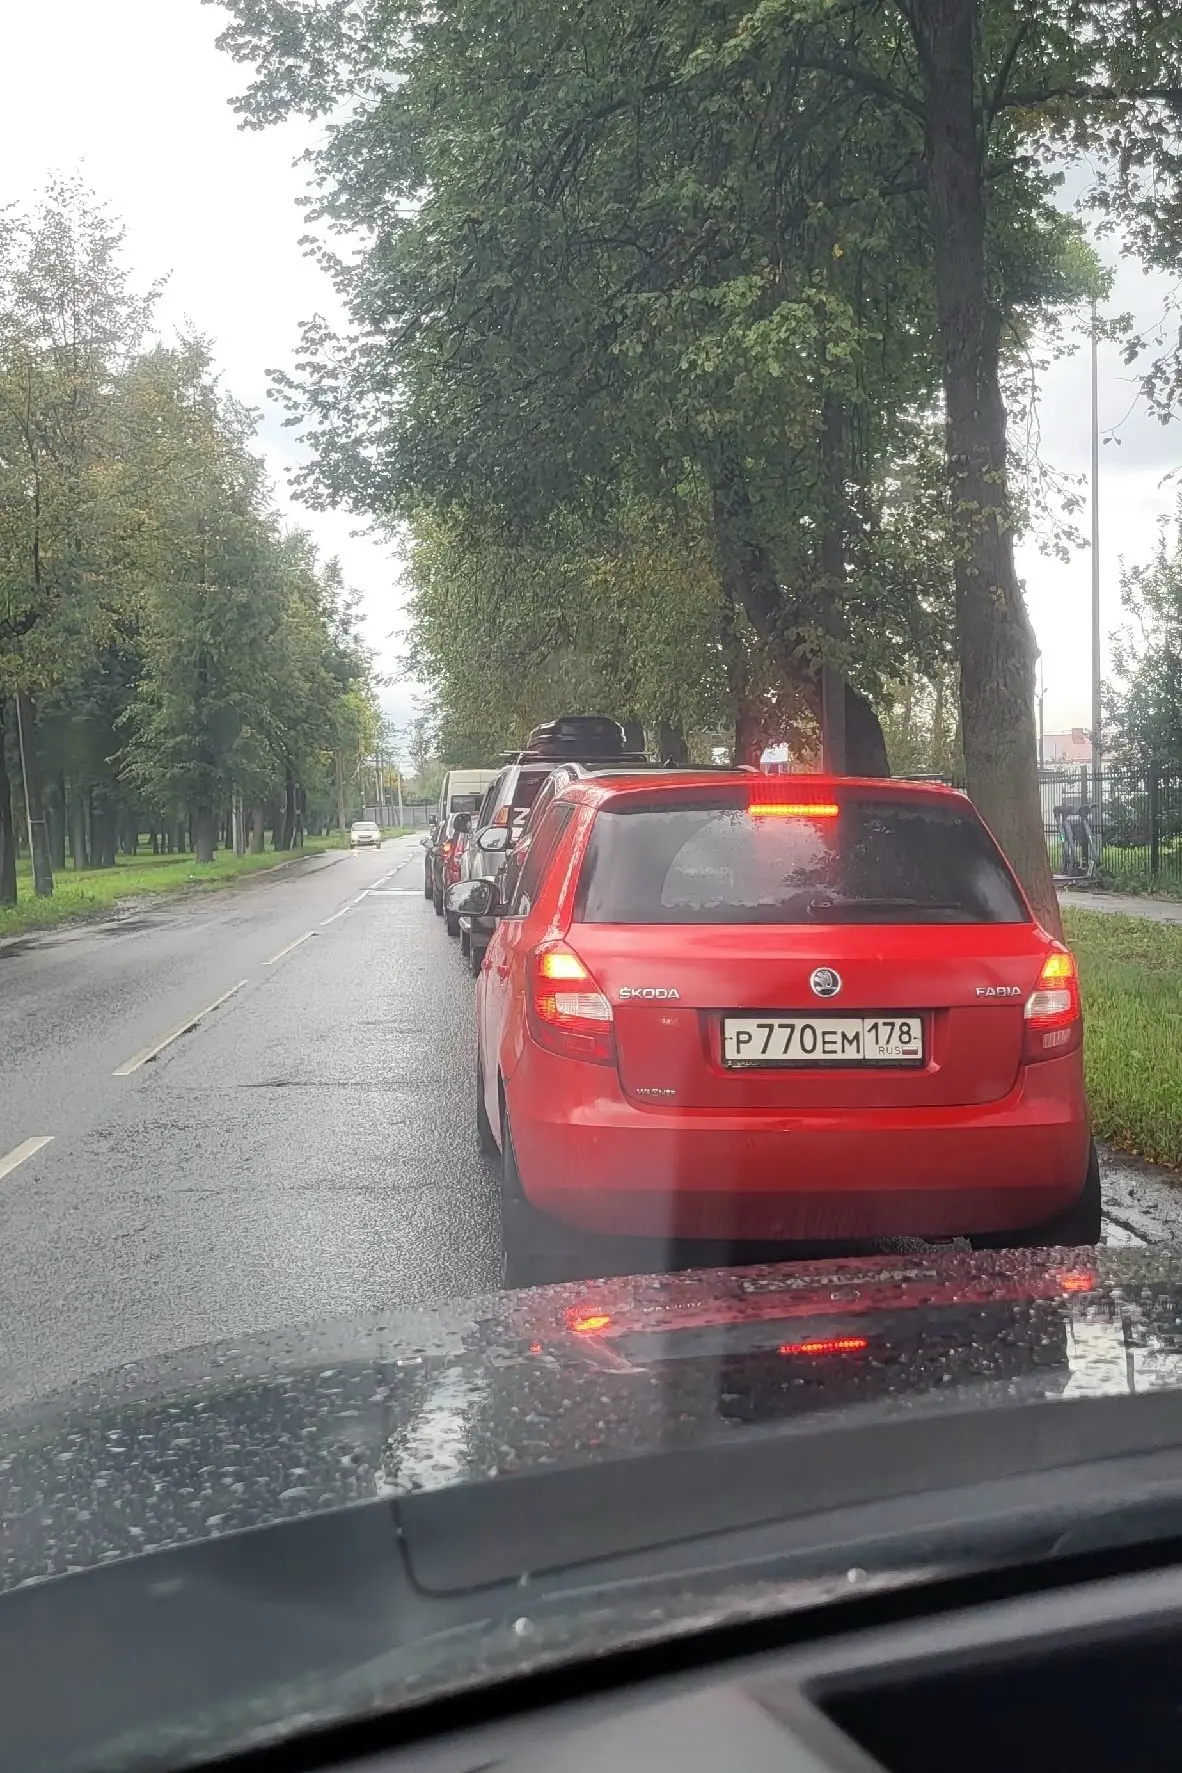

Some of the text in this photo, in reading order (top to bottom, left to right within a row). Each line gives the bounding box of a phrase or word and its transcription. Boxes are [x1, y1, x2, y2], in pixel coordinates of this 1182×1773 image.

[619, 986, 680, 999] ŠKODA
[975, 986, 1021, 997] FABIA
[867, 1021, 912, 1045] 178
[878, 1045, 901, 1055] RUS
